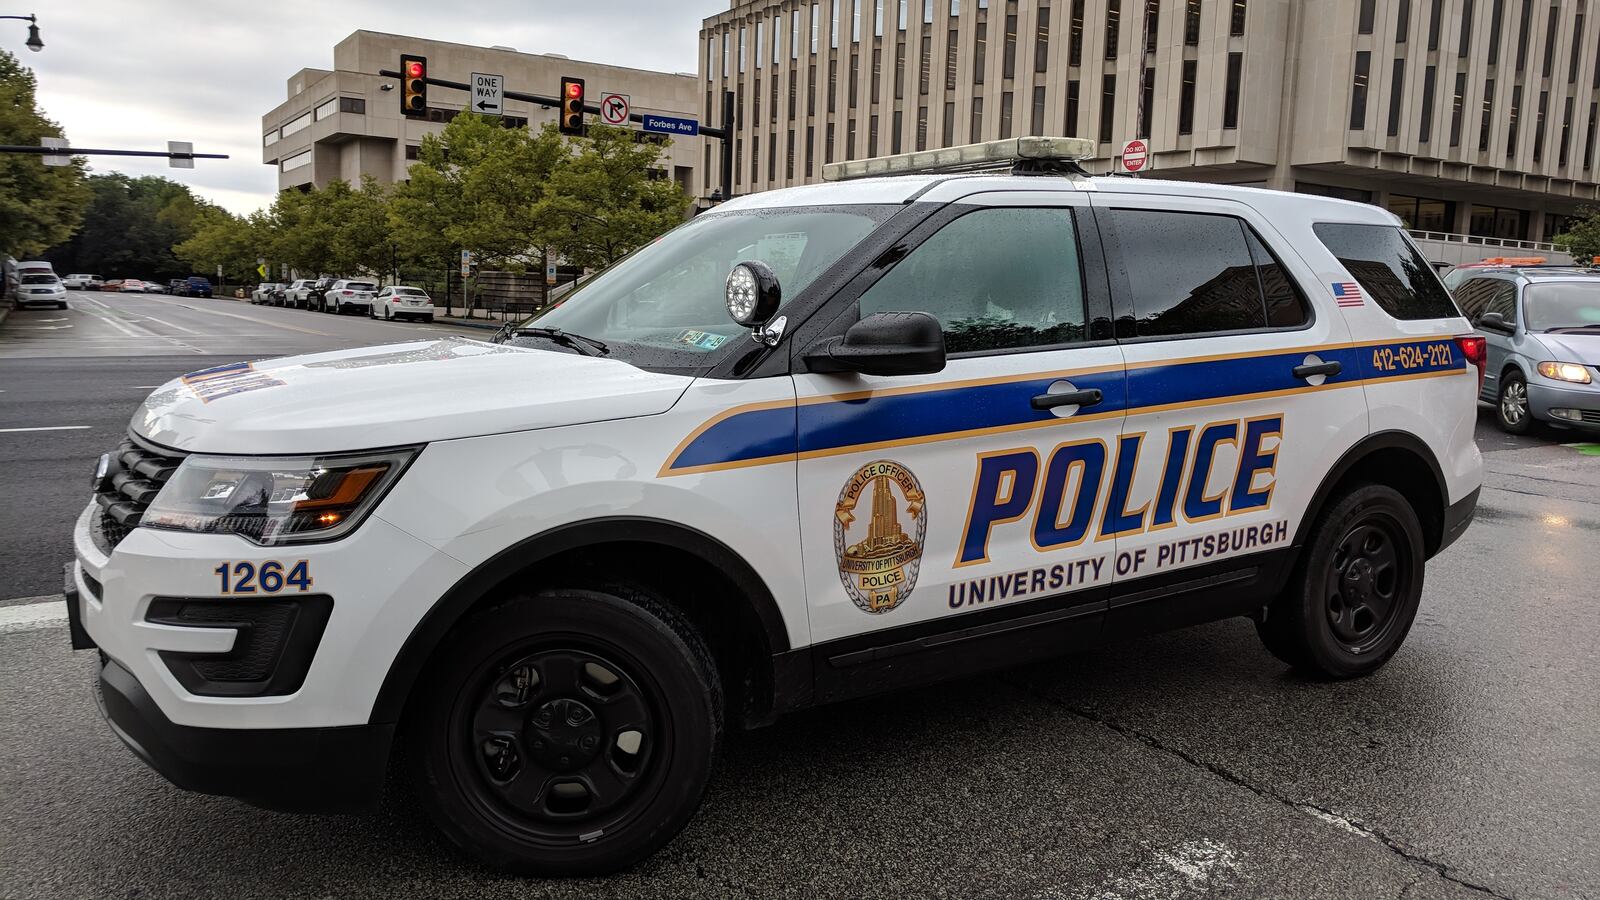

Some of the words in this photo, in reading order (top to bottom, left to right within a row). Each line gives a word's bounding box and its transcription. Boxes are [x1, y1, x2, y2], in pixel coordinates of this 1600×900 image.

[476, 87, 498, 98] WAY
[477, 76, 497, 88] ONE
[648, 118, 676, 130] Forbes
[678, 122, 693, 132] Ave
[1372, 343, 1453, 371] 412-624-2121
[847, 466, 877, 500] POLICE
[878, 464, 914, 493] OFFICER
[953, 413, 1284, 569] POLICE
[842, 557, 876, 571] UNIVERSITY
[875, 559, 884, 569] OF
[883, 547, 919, 569] PITTSBURGH
[948, 556, 1105, 609] UNIVERSITY
[1115, 549, 1147, 576] OF
[1156, 519, 1289, 568] PITTSBURGH
[214, 559, 314, 595] 1264
[862, 572, 901, 587] POLICE
[875, 592, 891, 605] PA
